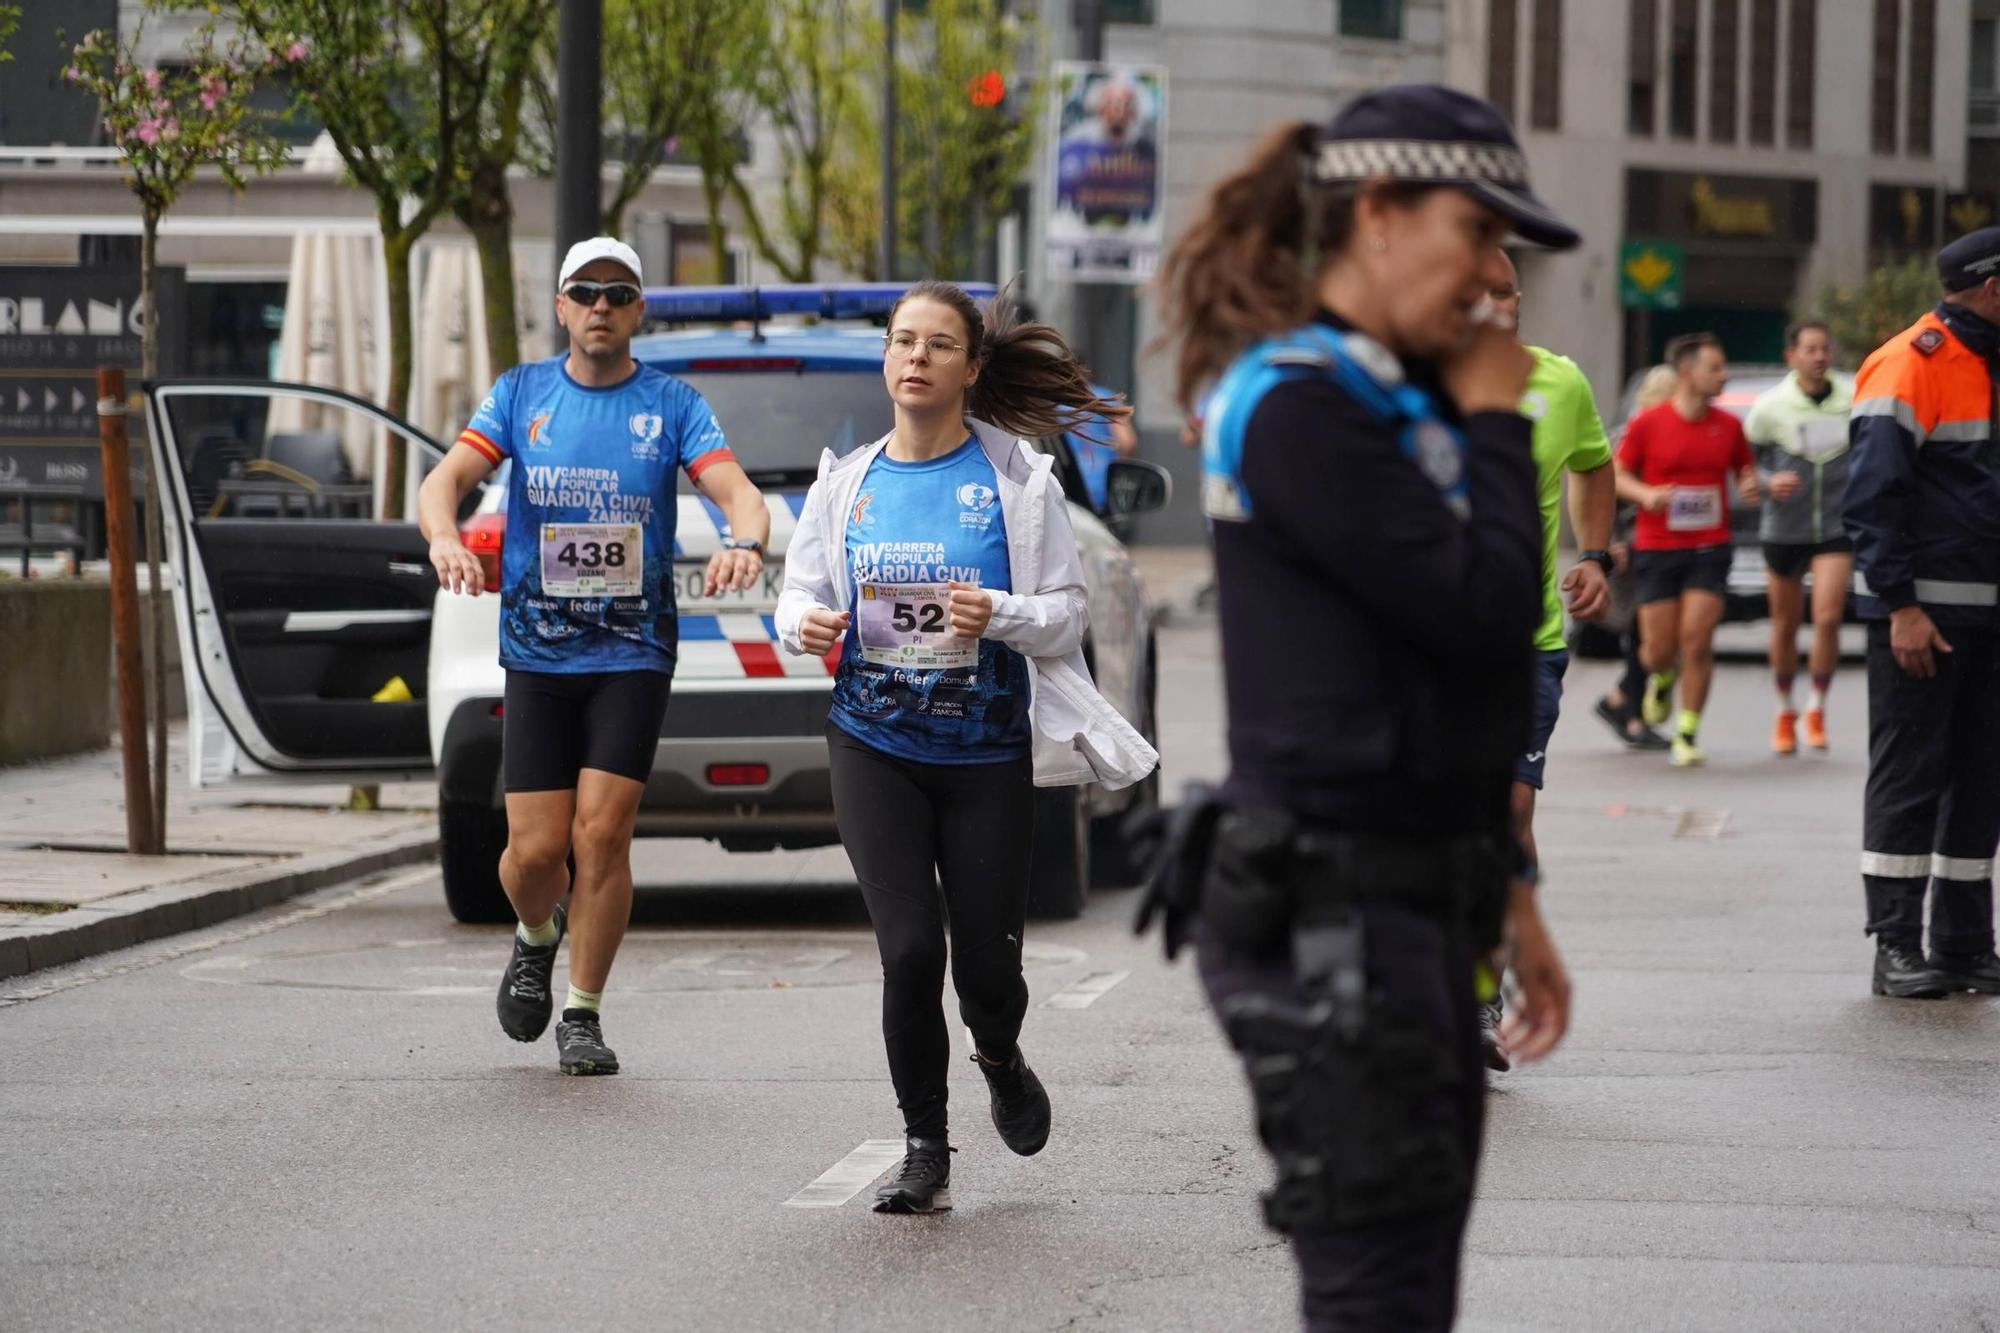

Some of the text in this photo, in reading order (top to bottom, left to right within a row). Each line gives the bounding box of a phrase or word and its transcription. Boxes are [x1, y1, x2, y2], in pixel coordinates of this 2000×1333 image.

[525, 465, 619, 490] XIV CARRERA
[560, 478, 618, 493] POPULAR
[527, 488, 654, 513] GUARDIA CIVIL
[558, 542, 626, 568] 438
[854, 542, 945, 567] XIV CARRERA
[883, 553, 945, 565] POPULAR
[577, 569, 606, 577] LOZANO
[935, 565, 984, 585] CIVIL
[569, 599, 605, 613] feder
[891, 602, 945, 633] 52
[913, 635, 922, 645] PI
[893, 669, 929, 686] feder
[939, 675, 968, 686] Domus
[930, 707, 964, 717] ZAMORA
